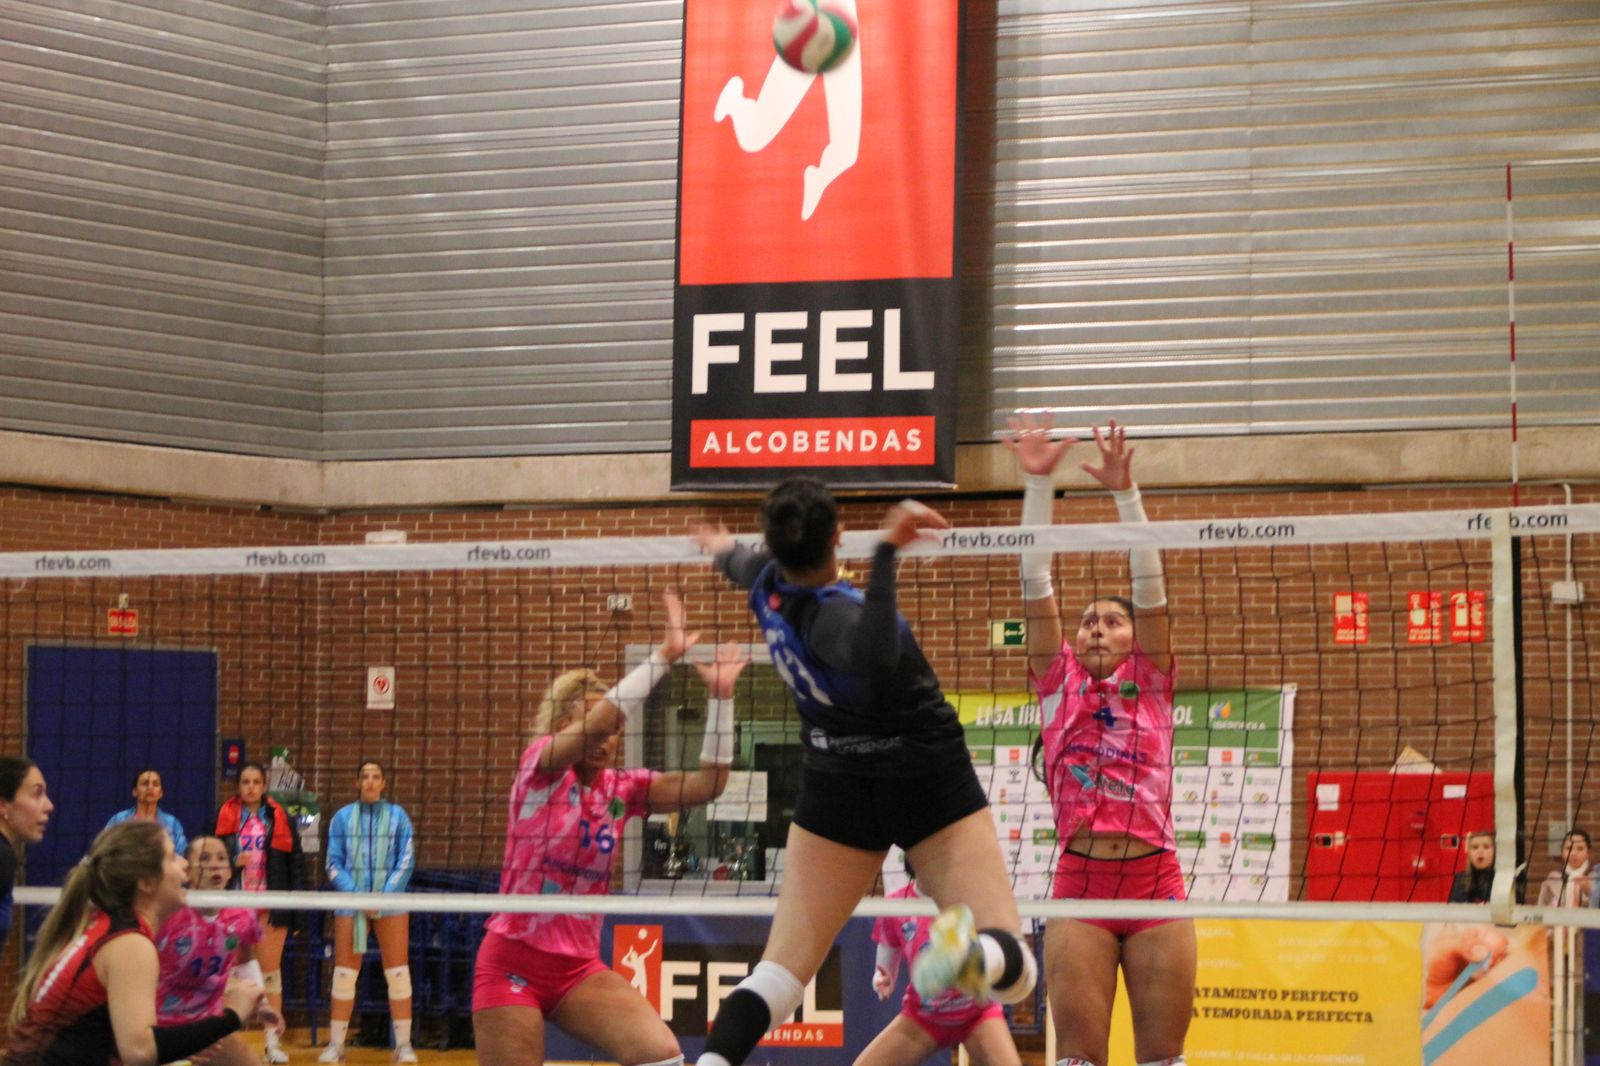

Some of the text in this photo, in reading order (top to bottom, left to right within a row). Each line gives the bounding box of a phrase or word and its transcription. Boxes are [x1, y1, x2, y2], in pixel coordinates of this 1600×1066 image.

[691, 308, 935, 394] FEEL
[702, 428, 922, 454] ALCOBENDAS
[1467, 511, 1568, 530] rfeb.com
[942, 531, 1035, 548] rfevb.com
[1199, 522, 1295, 540] rfevb.com
[246, 550, 326, 566] rfevb.com
[467, 544, 551, 561] rfevb.com
[35, 555, 111, 570] rfevb.com
[975, 704, 1014, 726] LIGA
[1092, 706, 1118, 728] 4
[241, 834, 266, 851] 26
[579, 820, 615, 854] 16
[191, 956, 223, 977] 13
[660, 961, 844, 1023] FEL
[1194, 988, 1359, 1003] ATAMIENTO PERFECTO
[1202, 1007, 1293, 1022] TEMPORADA
[1296, 1010, 1374, 1024] PERFECTA
[763, 1029, 824, 1041] BENDAS
